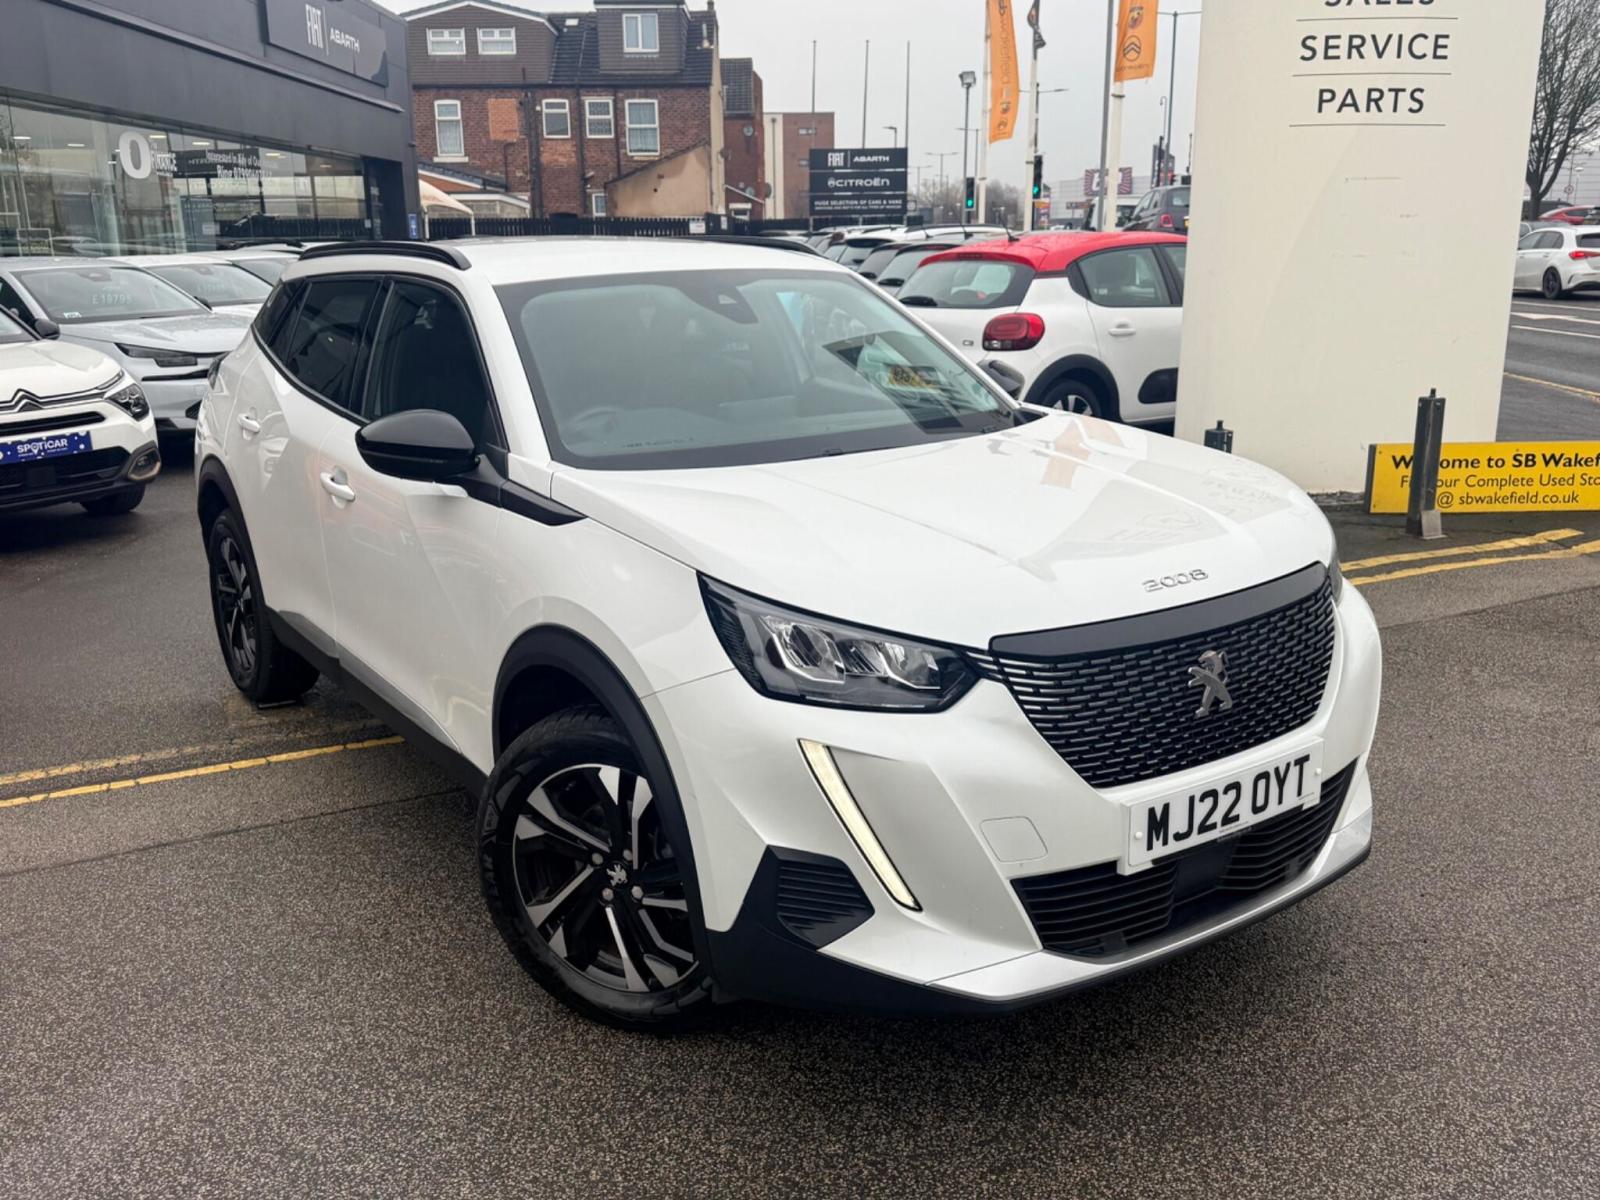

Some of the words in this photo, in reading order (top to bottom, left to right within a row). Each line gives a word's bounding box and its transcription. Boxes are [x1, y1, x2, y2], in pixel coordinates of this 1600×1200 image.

[305, 4, 323, 48] FIAT
[330, 27, 360, 53] ABARTH
[1300, 33, 1450, 61] SERVICE
[1317, 88, 1425, 113] PARTS
[828, 152, 844, 167] FIAT
[17, 438, 68, 454] SPOTICAR
[1392, 455, 1480, 469] Wome
[1487, 456, 1505, 468] to
[1512, 453, 1537, 468] SB
[1465, 474, 1534, 490] Complete
[1539, 473, 1575, 487] Used
[1437, 491, 1453, 508] @
[1459, 490, 1580, 504] sbwakefield.co.uk
[1142, 569, 1208, 593] 2008
[1147, 781, 1241, 851] MJ22
[1251, 754, 1310, 815] OYT
